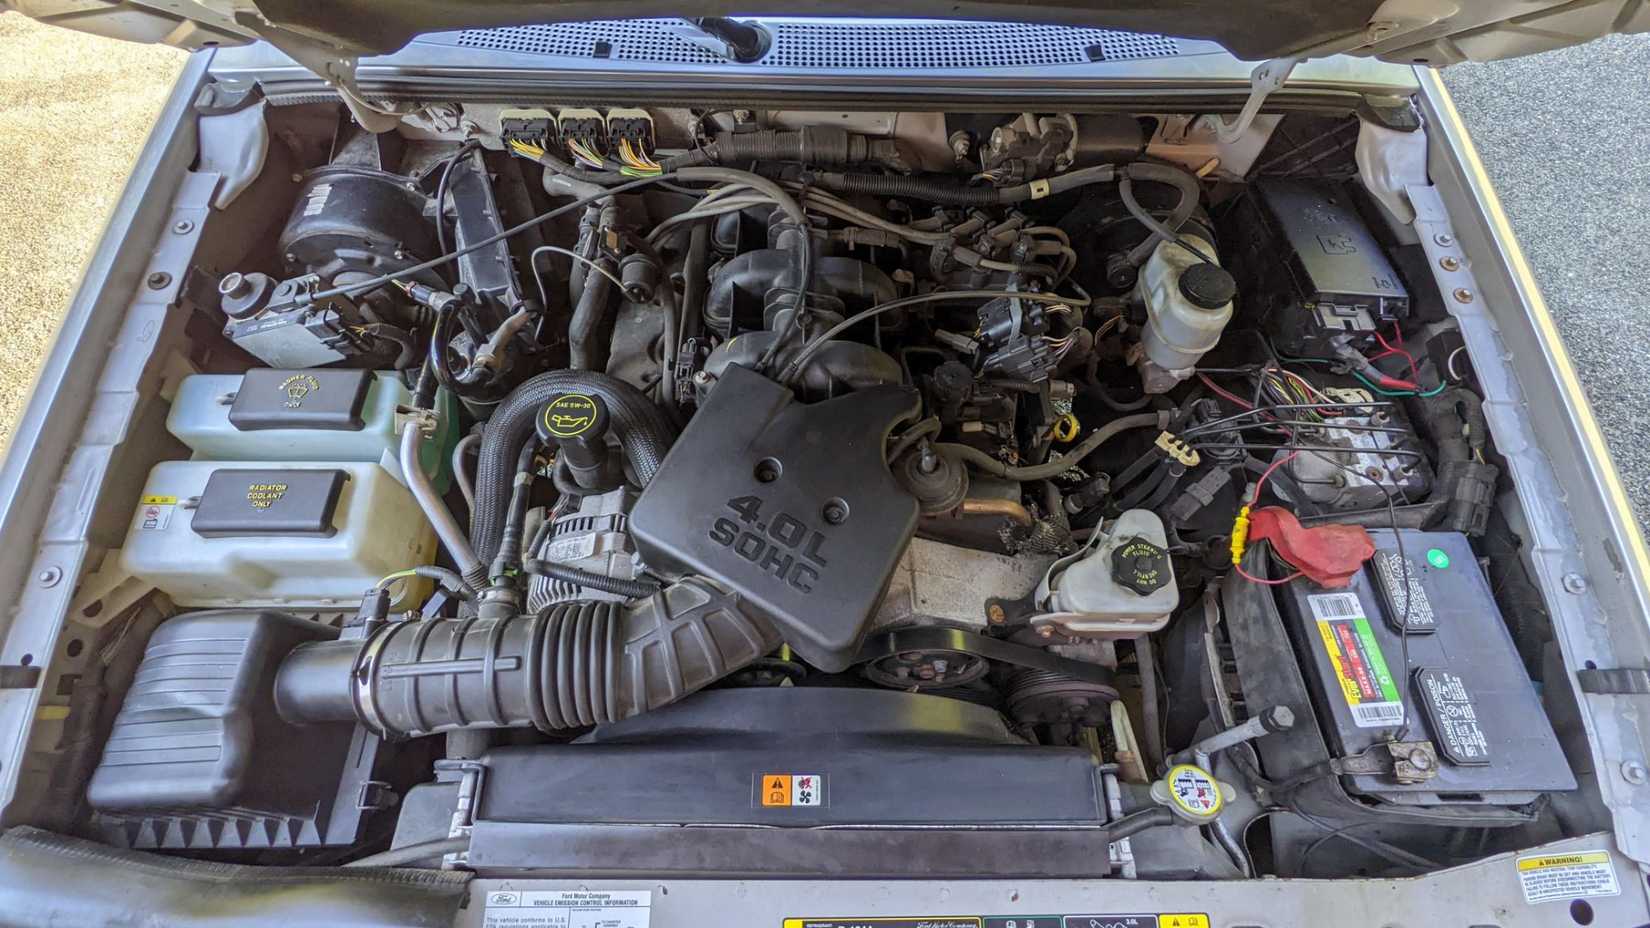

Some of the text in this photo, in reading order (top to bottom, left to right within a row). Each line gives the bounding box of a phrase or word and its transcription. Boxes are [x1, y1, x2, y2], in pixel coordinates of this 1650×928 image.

[727, 495, 828, 568] 4.0L
[709, 517, 819, 594] SOHC
[1426, 679, 1441, 708] POISON
[1440, 714, 1457, 746] DANGER
[1545, 856, 1582, 865] WARNING!
[496, 895, 511, 903] Ford
